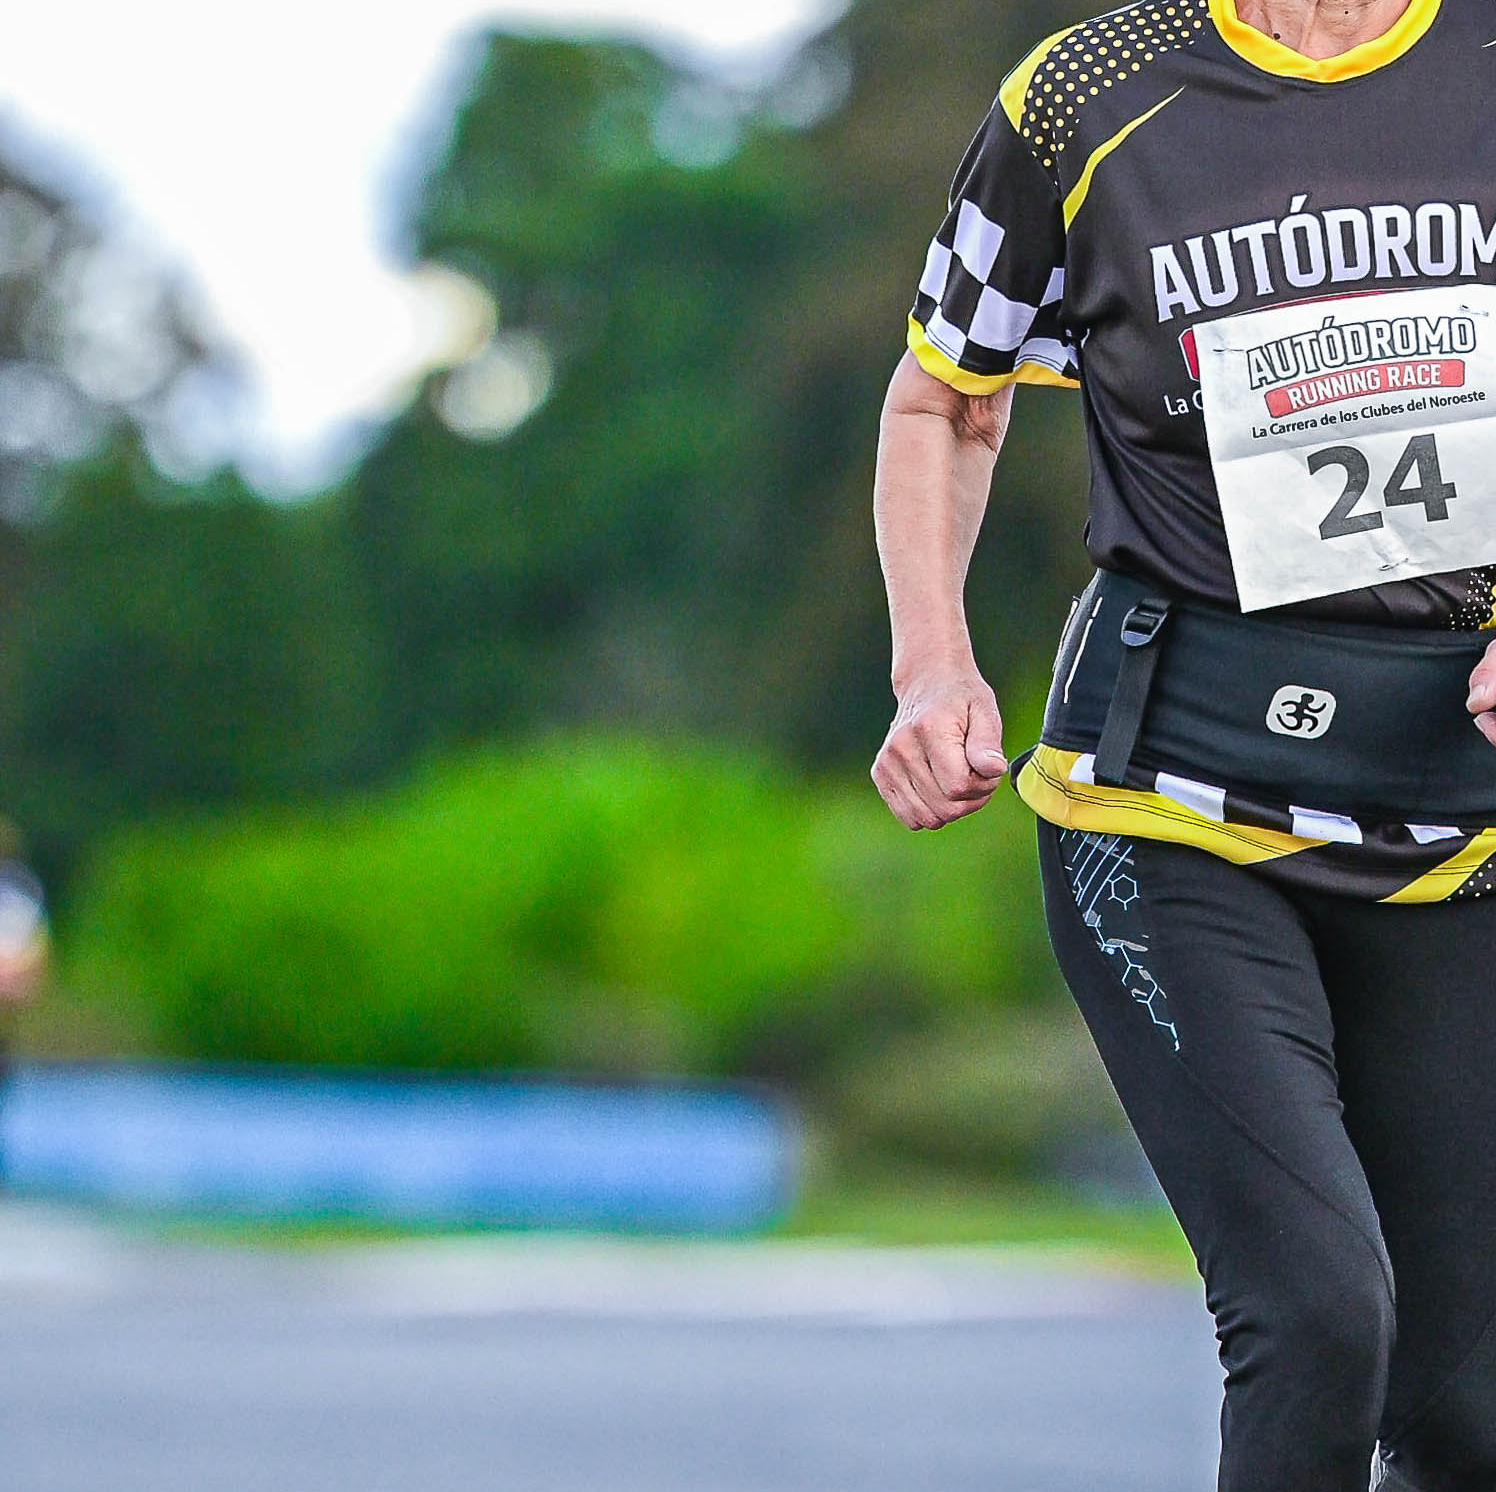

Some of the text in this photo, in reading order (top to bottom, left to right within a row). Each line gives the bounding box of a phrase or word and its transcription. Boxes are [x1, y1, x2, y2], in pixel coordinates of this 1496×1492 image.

[1246, 316, 1477, 390] AUTÓDROMO
[1163, 394, 1189, 416] La
[1286, 363, 1442, 410] RUNNING RACE
[1252, 391, 1486, 438] La Carrera de los Clubes del Noroeste
[1306, 434, 1457, 540] 24
